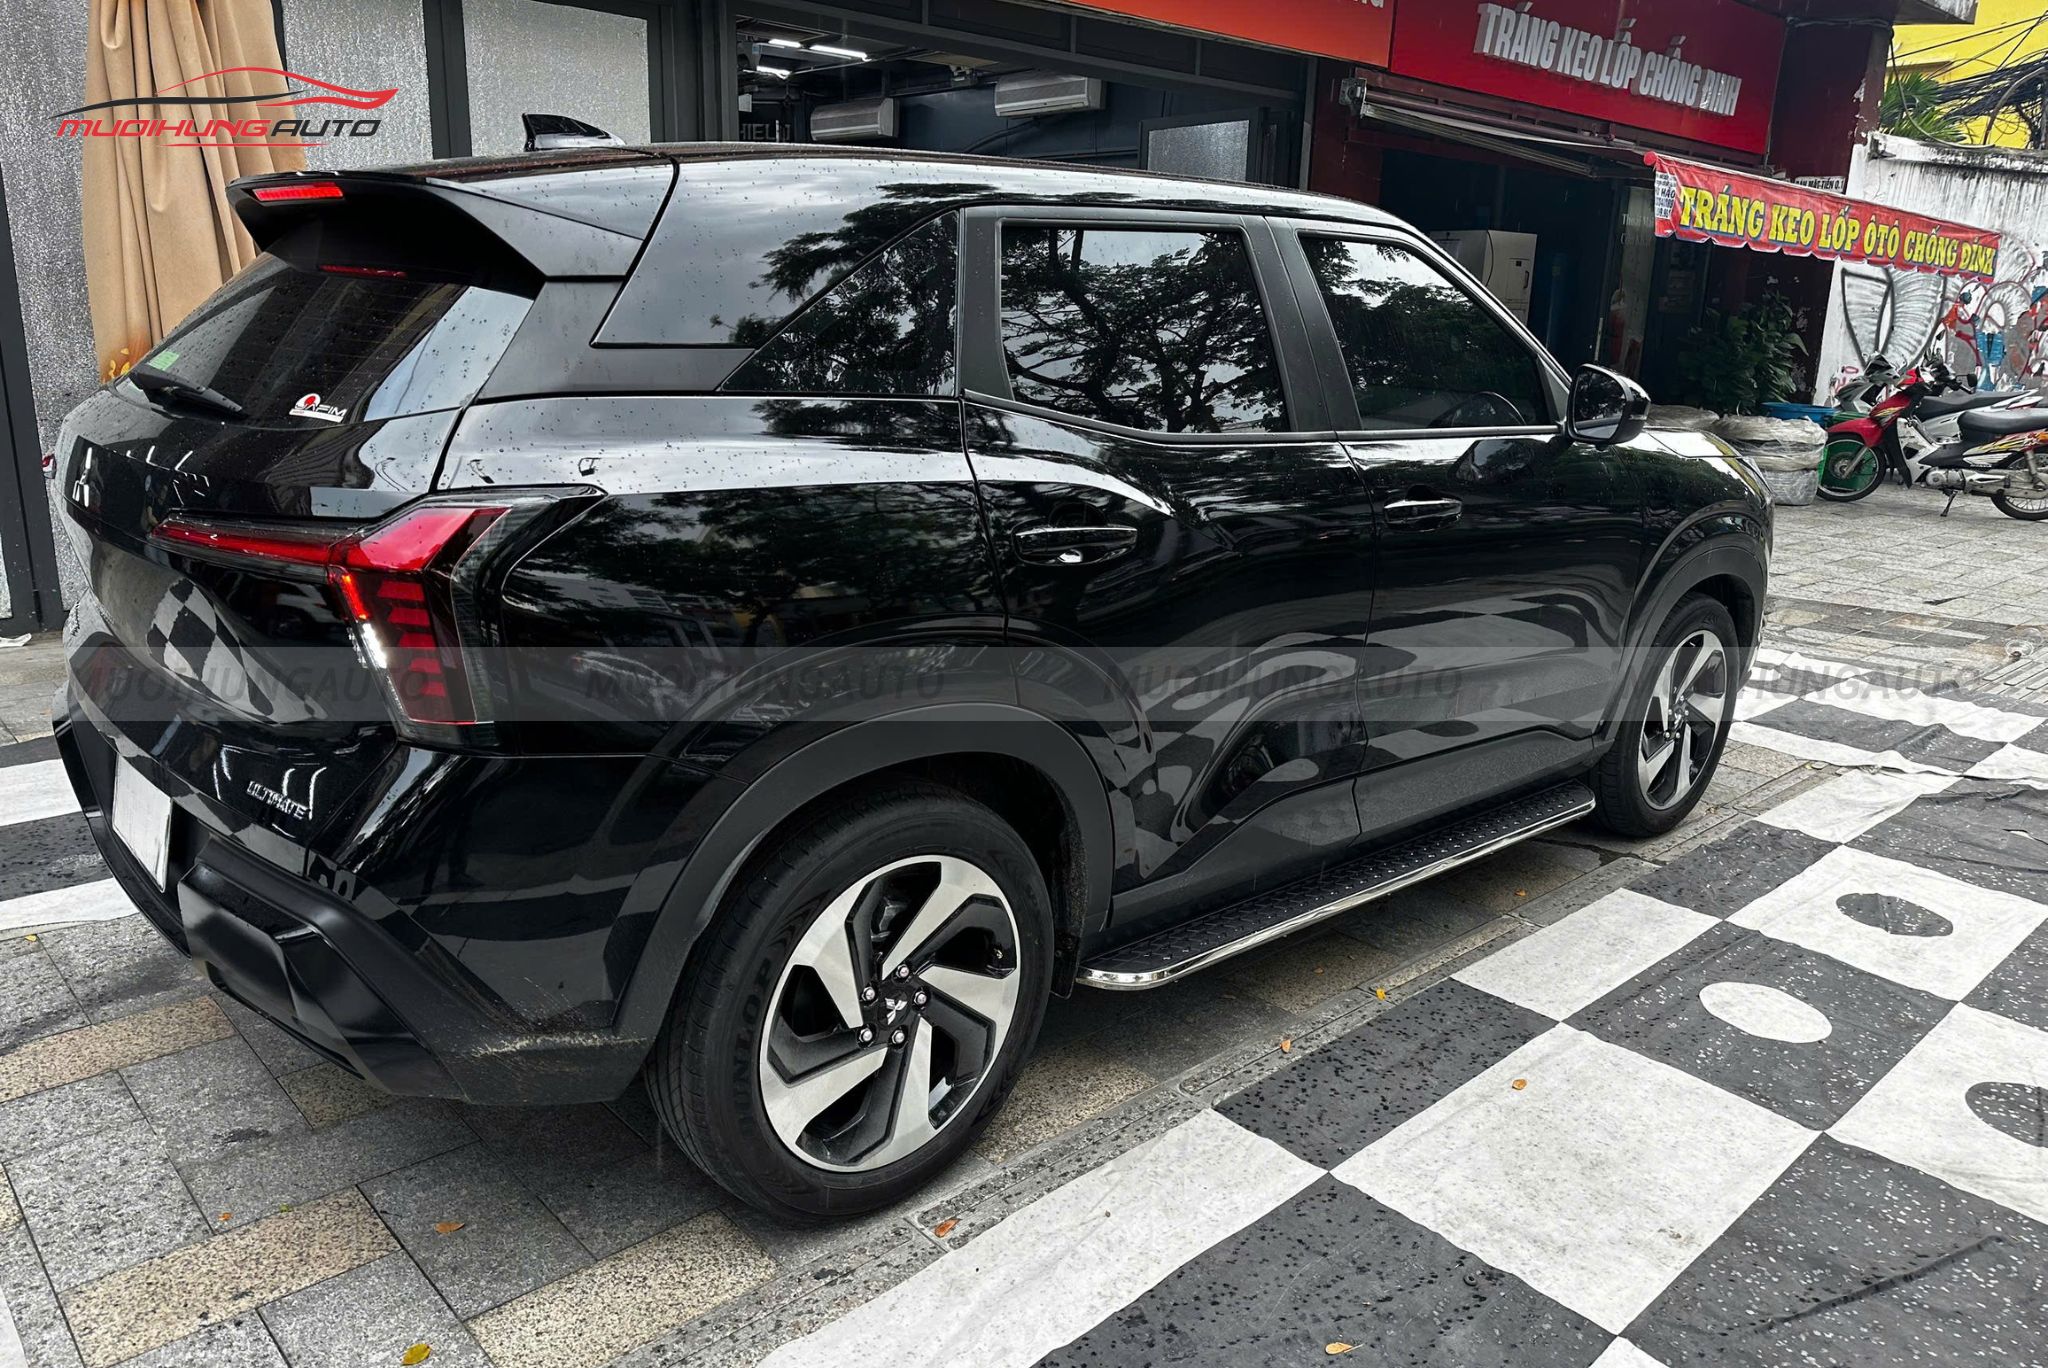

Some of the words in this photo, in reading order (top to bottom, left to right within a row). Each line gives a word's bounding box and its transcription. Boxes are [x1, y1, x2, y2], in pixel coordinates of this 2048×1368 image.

[1478, 1, 1561, 70] TRÁNG
[1555, 26, 1604, 83] KEO
[1599, 18, 1642, 90] LỐP
[1638, 35, 1702, 107] CHỐNG
[1680, 184, 1766, 240] TRÁNG
[1768, 203, 1816, 247] KEO
[1818, 205, 1861, 252] LỐP
[1863, 214, 1901, 260] ÔTÔ
[1903, 224, 1959, 269] CHỐNG
[246, 780, 309, 820] ULTIMATE
